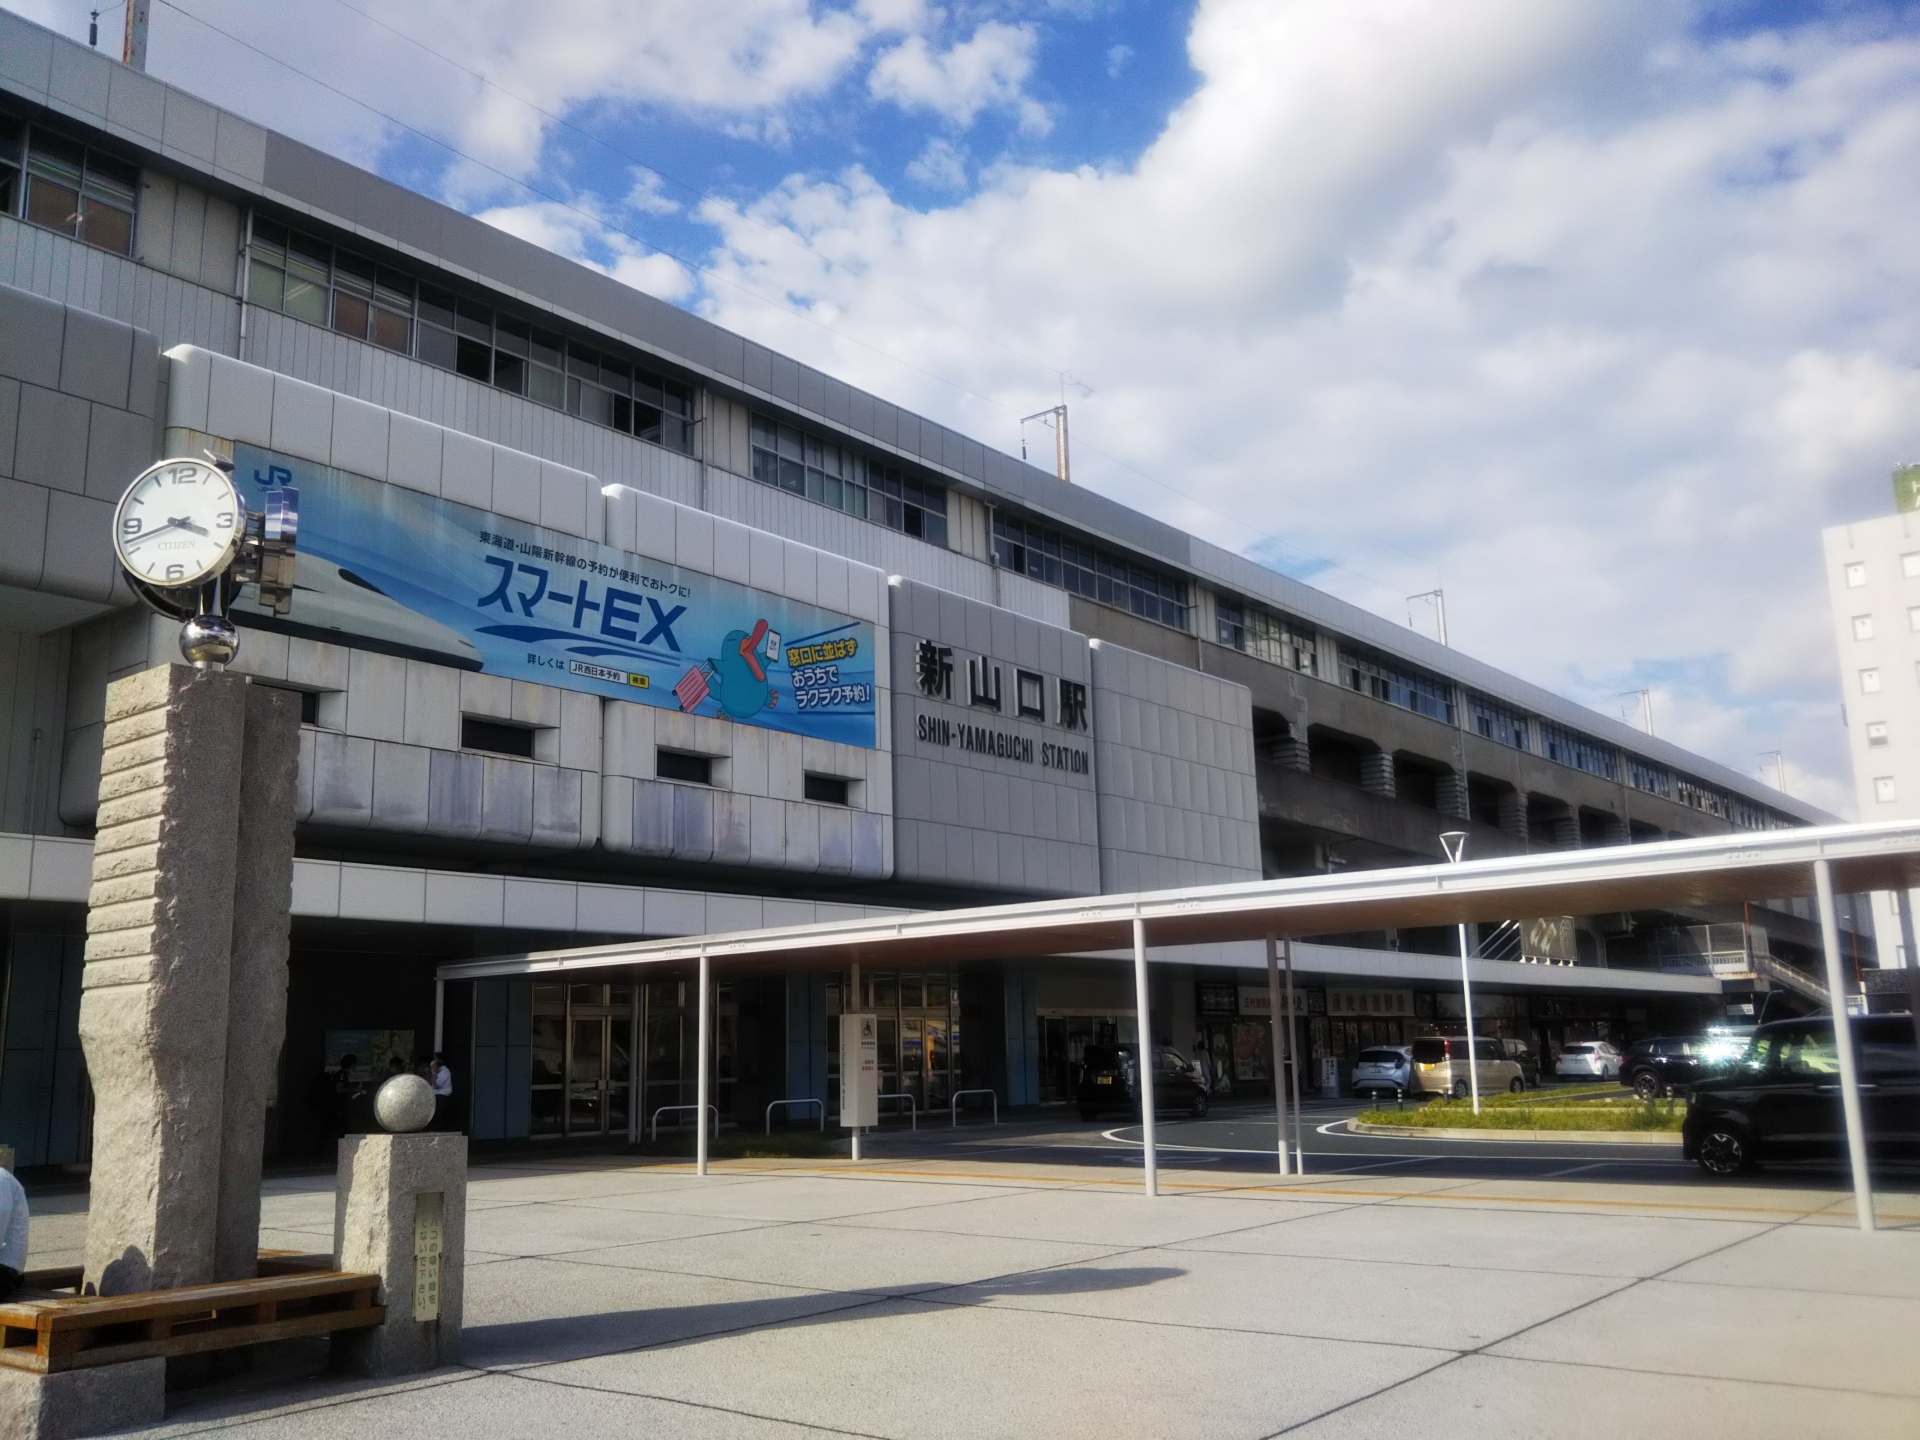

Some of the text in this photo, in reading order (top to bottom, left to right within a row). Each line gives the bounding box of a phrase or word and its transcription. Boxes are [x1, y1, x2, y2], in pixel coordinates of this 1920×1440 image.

[167, 467, 198, 485] 12
[253, 464, 292, 487] JR
[123, 517, 142, 535] 9
[216, 512, 233, 529] 3
[158, 540, 196, 551] CITIZEN
[165, 563, 184, 581] 6
[477, 554, 688, 652] スマートEX
[787, 638, 858, 666] 窓口に並ばず
[527, 653, 646, 686] 詳しくは JR西日本予約 検索
[792, 665, 838, 687] おうちで
[796, 684, 871, 708] ラクラク予約!
[916, 638, 1088, 732] 新山口駅
[916, 714, 1089, 775] SHIN-YAMAGUCHI STATION
[418, 1207, 428, 1310] てないで下さい。
[428, 1208, 439, 1305] バコの吸い殻を
